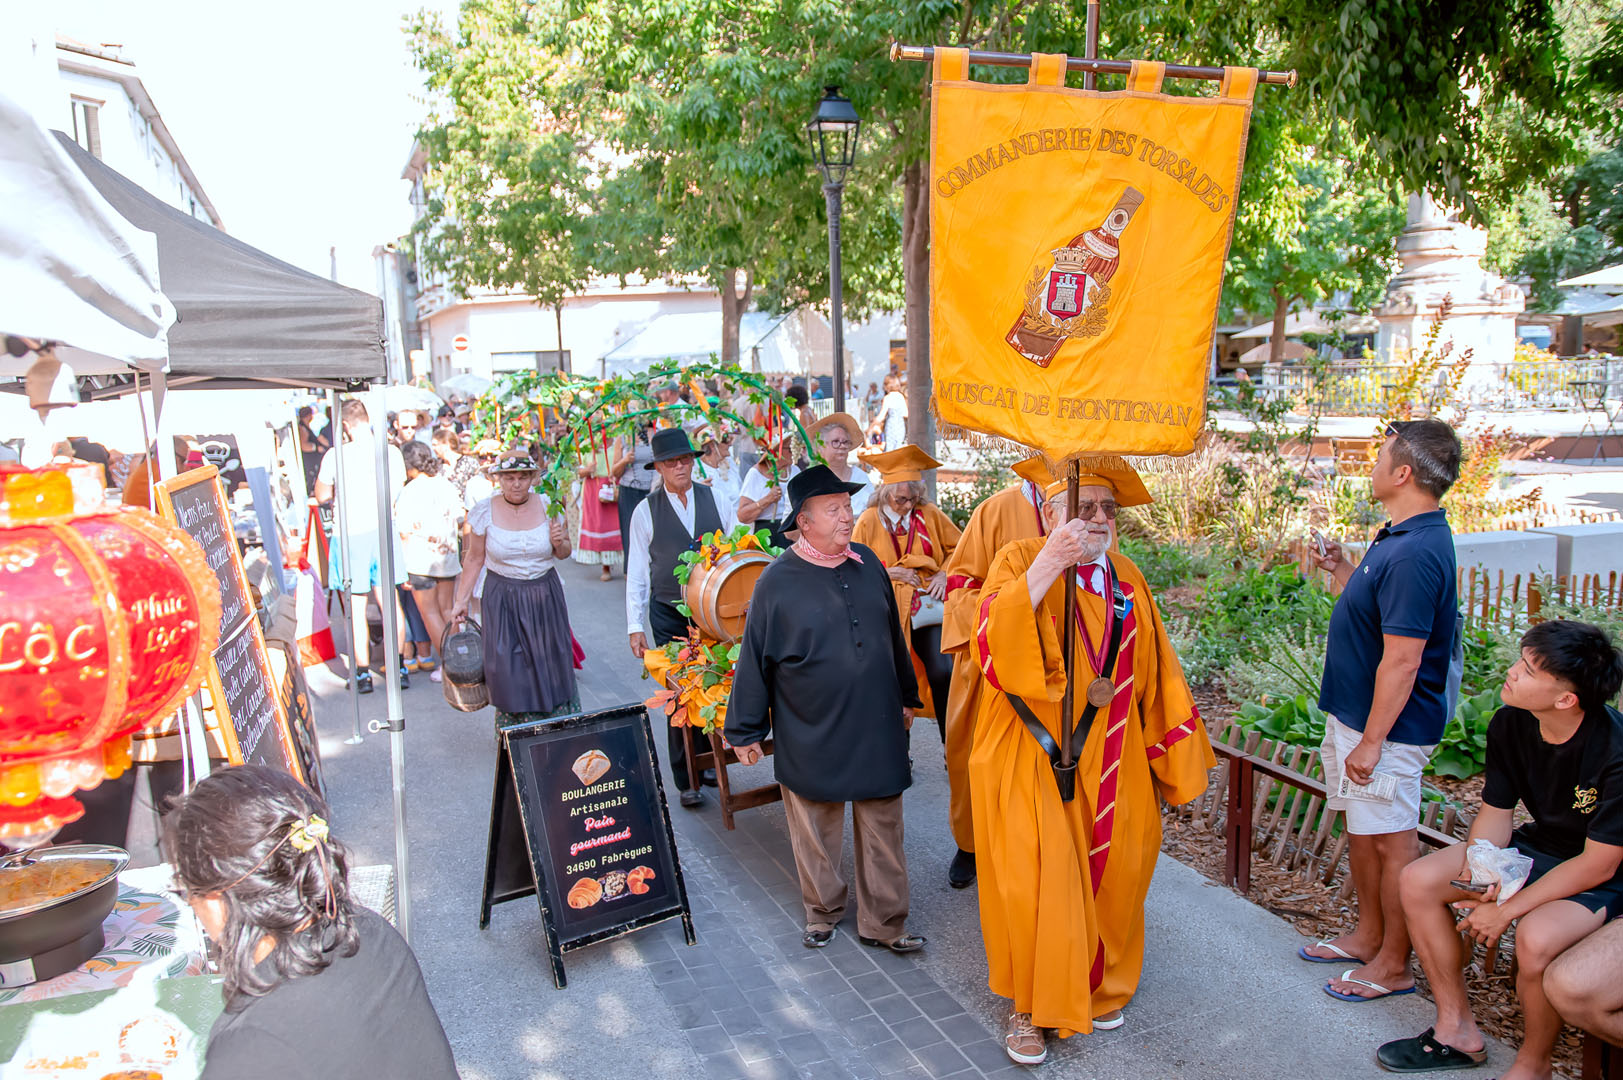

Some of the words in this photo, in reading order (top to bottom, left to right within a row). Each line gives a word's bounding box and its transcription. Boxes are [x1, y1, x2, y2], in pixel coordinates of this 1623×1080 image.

[936, 128, 1091, 198] COMMANDERIE
[1098, 128, 1137, 157] DES
[1139, 138, 1230, 213] TORSADES
[938, 380, 1017, 409] MUSCAT
[1021, 391, 1050, 416] DE
[1057, 398, 1194, 427] FRONTIGNAN
[561, 779, 626, 802] BOULANGERIE
[570, 796, 628, 817] Artisanale
[584, 815, 616, 832] Pain
[570, 826, 631, 856] gourmand
[566, 859, 596, 875] 34690
[601, 845, 653, 866] Fabrègues
